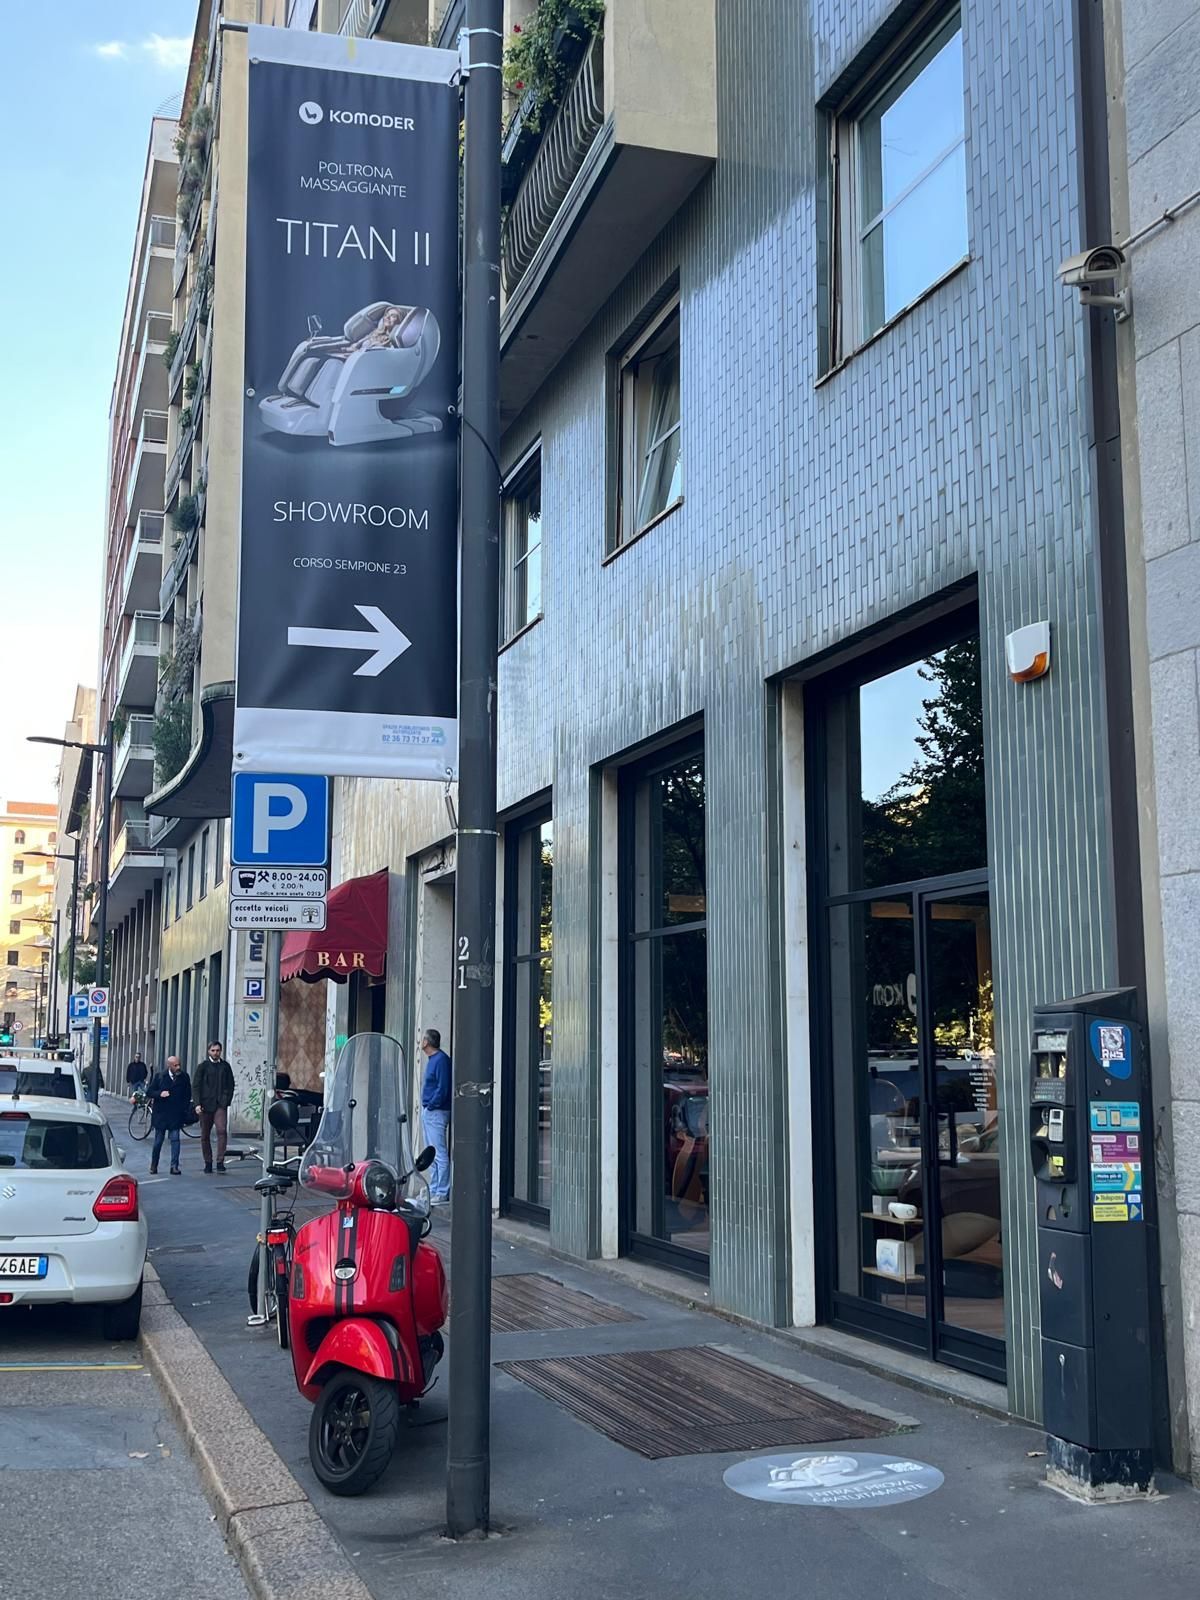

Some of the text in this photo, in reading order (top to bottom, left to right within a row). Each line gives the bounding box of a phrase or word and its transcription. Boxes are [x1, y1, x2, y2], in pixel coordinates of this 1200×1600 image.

[329, 109, 415, 131] KOMODER
[319, 160, 394, 180] POLTRONA
[300, 176, 408, 199] MASSAGGIANTE
[276, 217, 430, 267] TITAN II
[272, 500, 429, 530] SHOWROOM
[293, 557, 407, 575] CORSO SEMPIONE 23
[252, 782, 308, 854] P
[235, 904, 261, 912] eccetto
[251, 915, 297, 924] contrassegno
[318, 952, 365, 968] BAR
[248, 981, 260, 995] P
[74, 997, 88, 1016] P
[0, 1258, 37, 1274] 46AE
